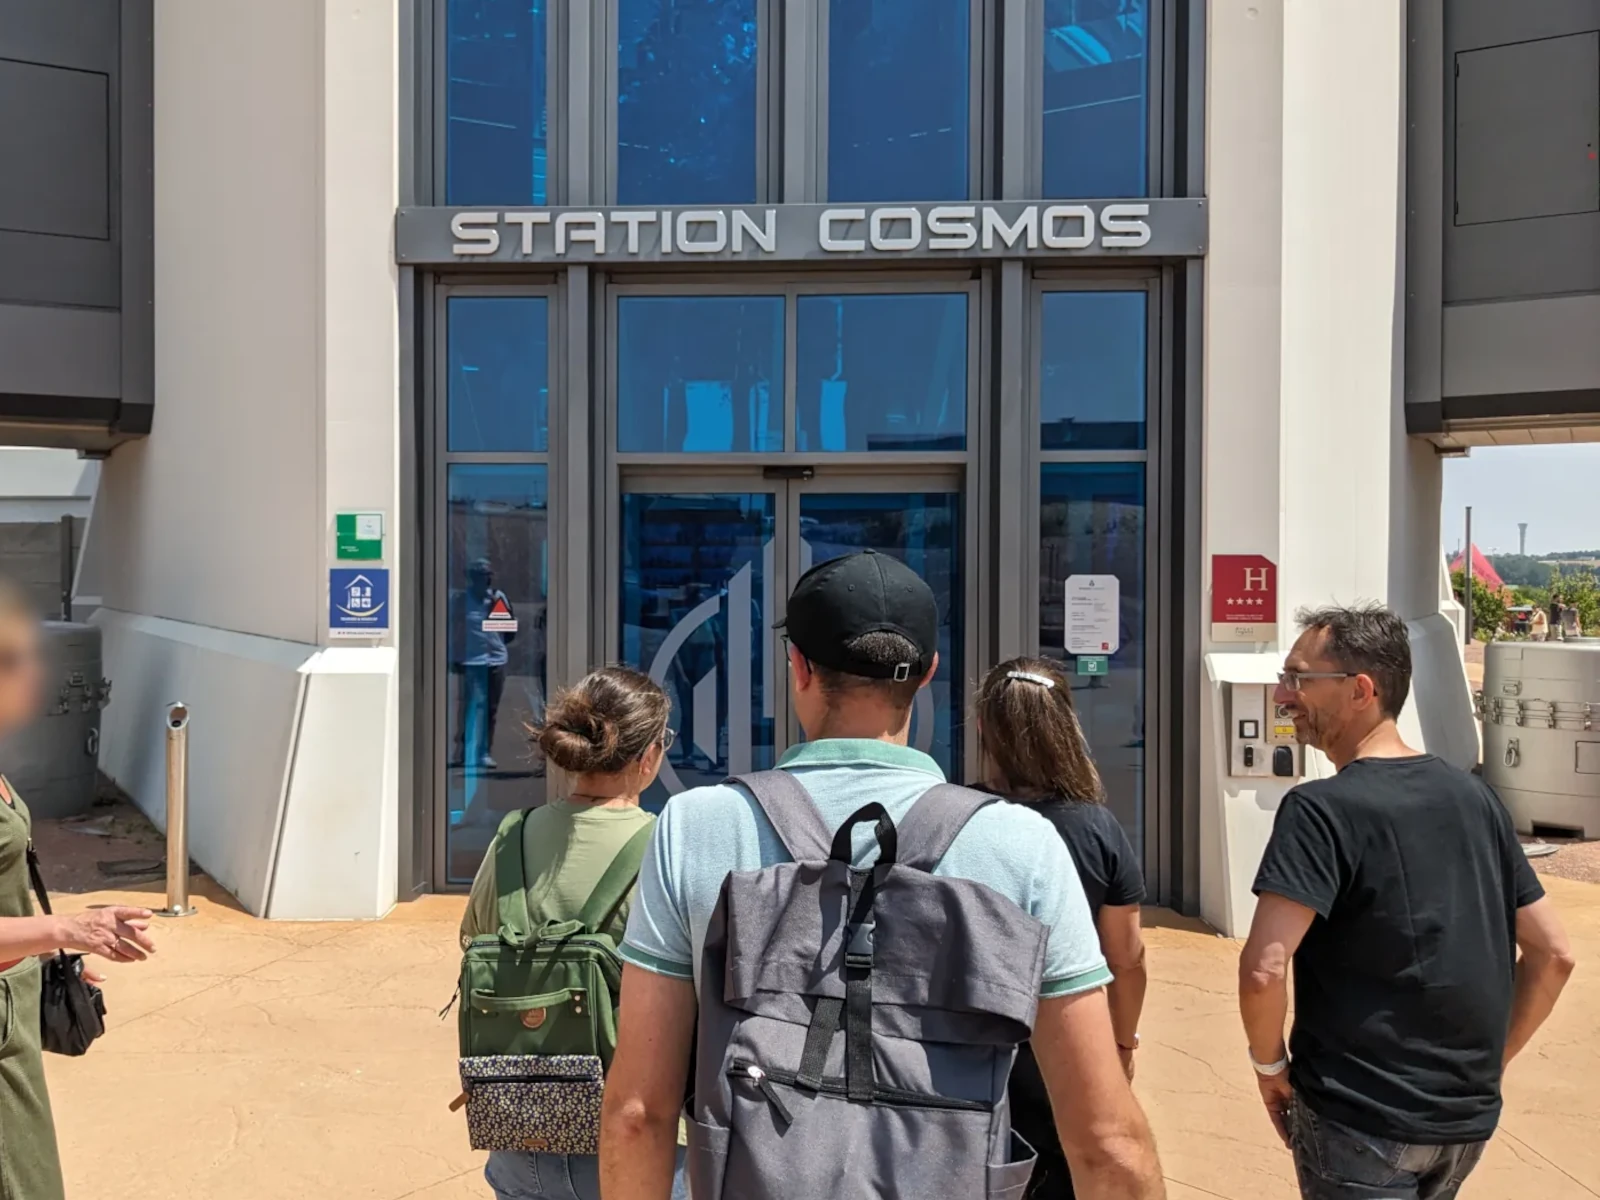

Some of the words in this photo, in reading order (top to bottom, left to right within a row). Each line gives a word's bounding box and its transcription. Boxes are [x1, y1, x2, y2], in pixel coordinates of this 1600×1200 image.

[451, 208, 777, 255] STATION
[818, 202, 1152, 253] COSMOS
[1243, 567, 1269, 591] H
